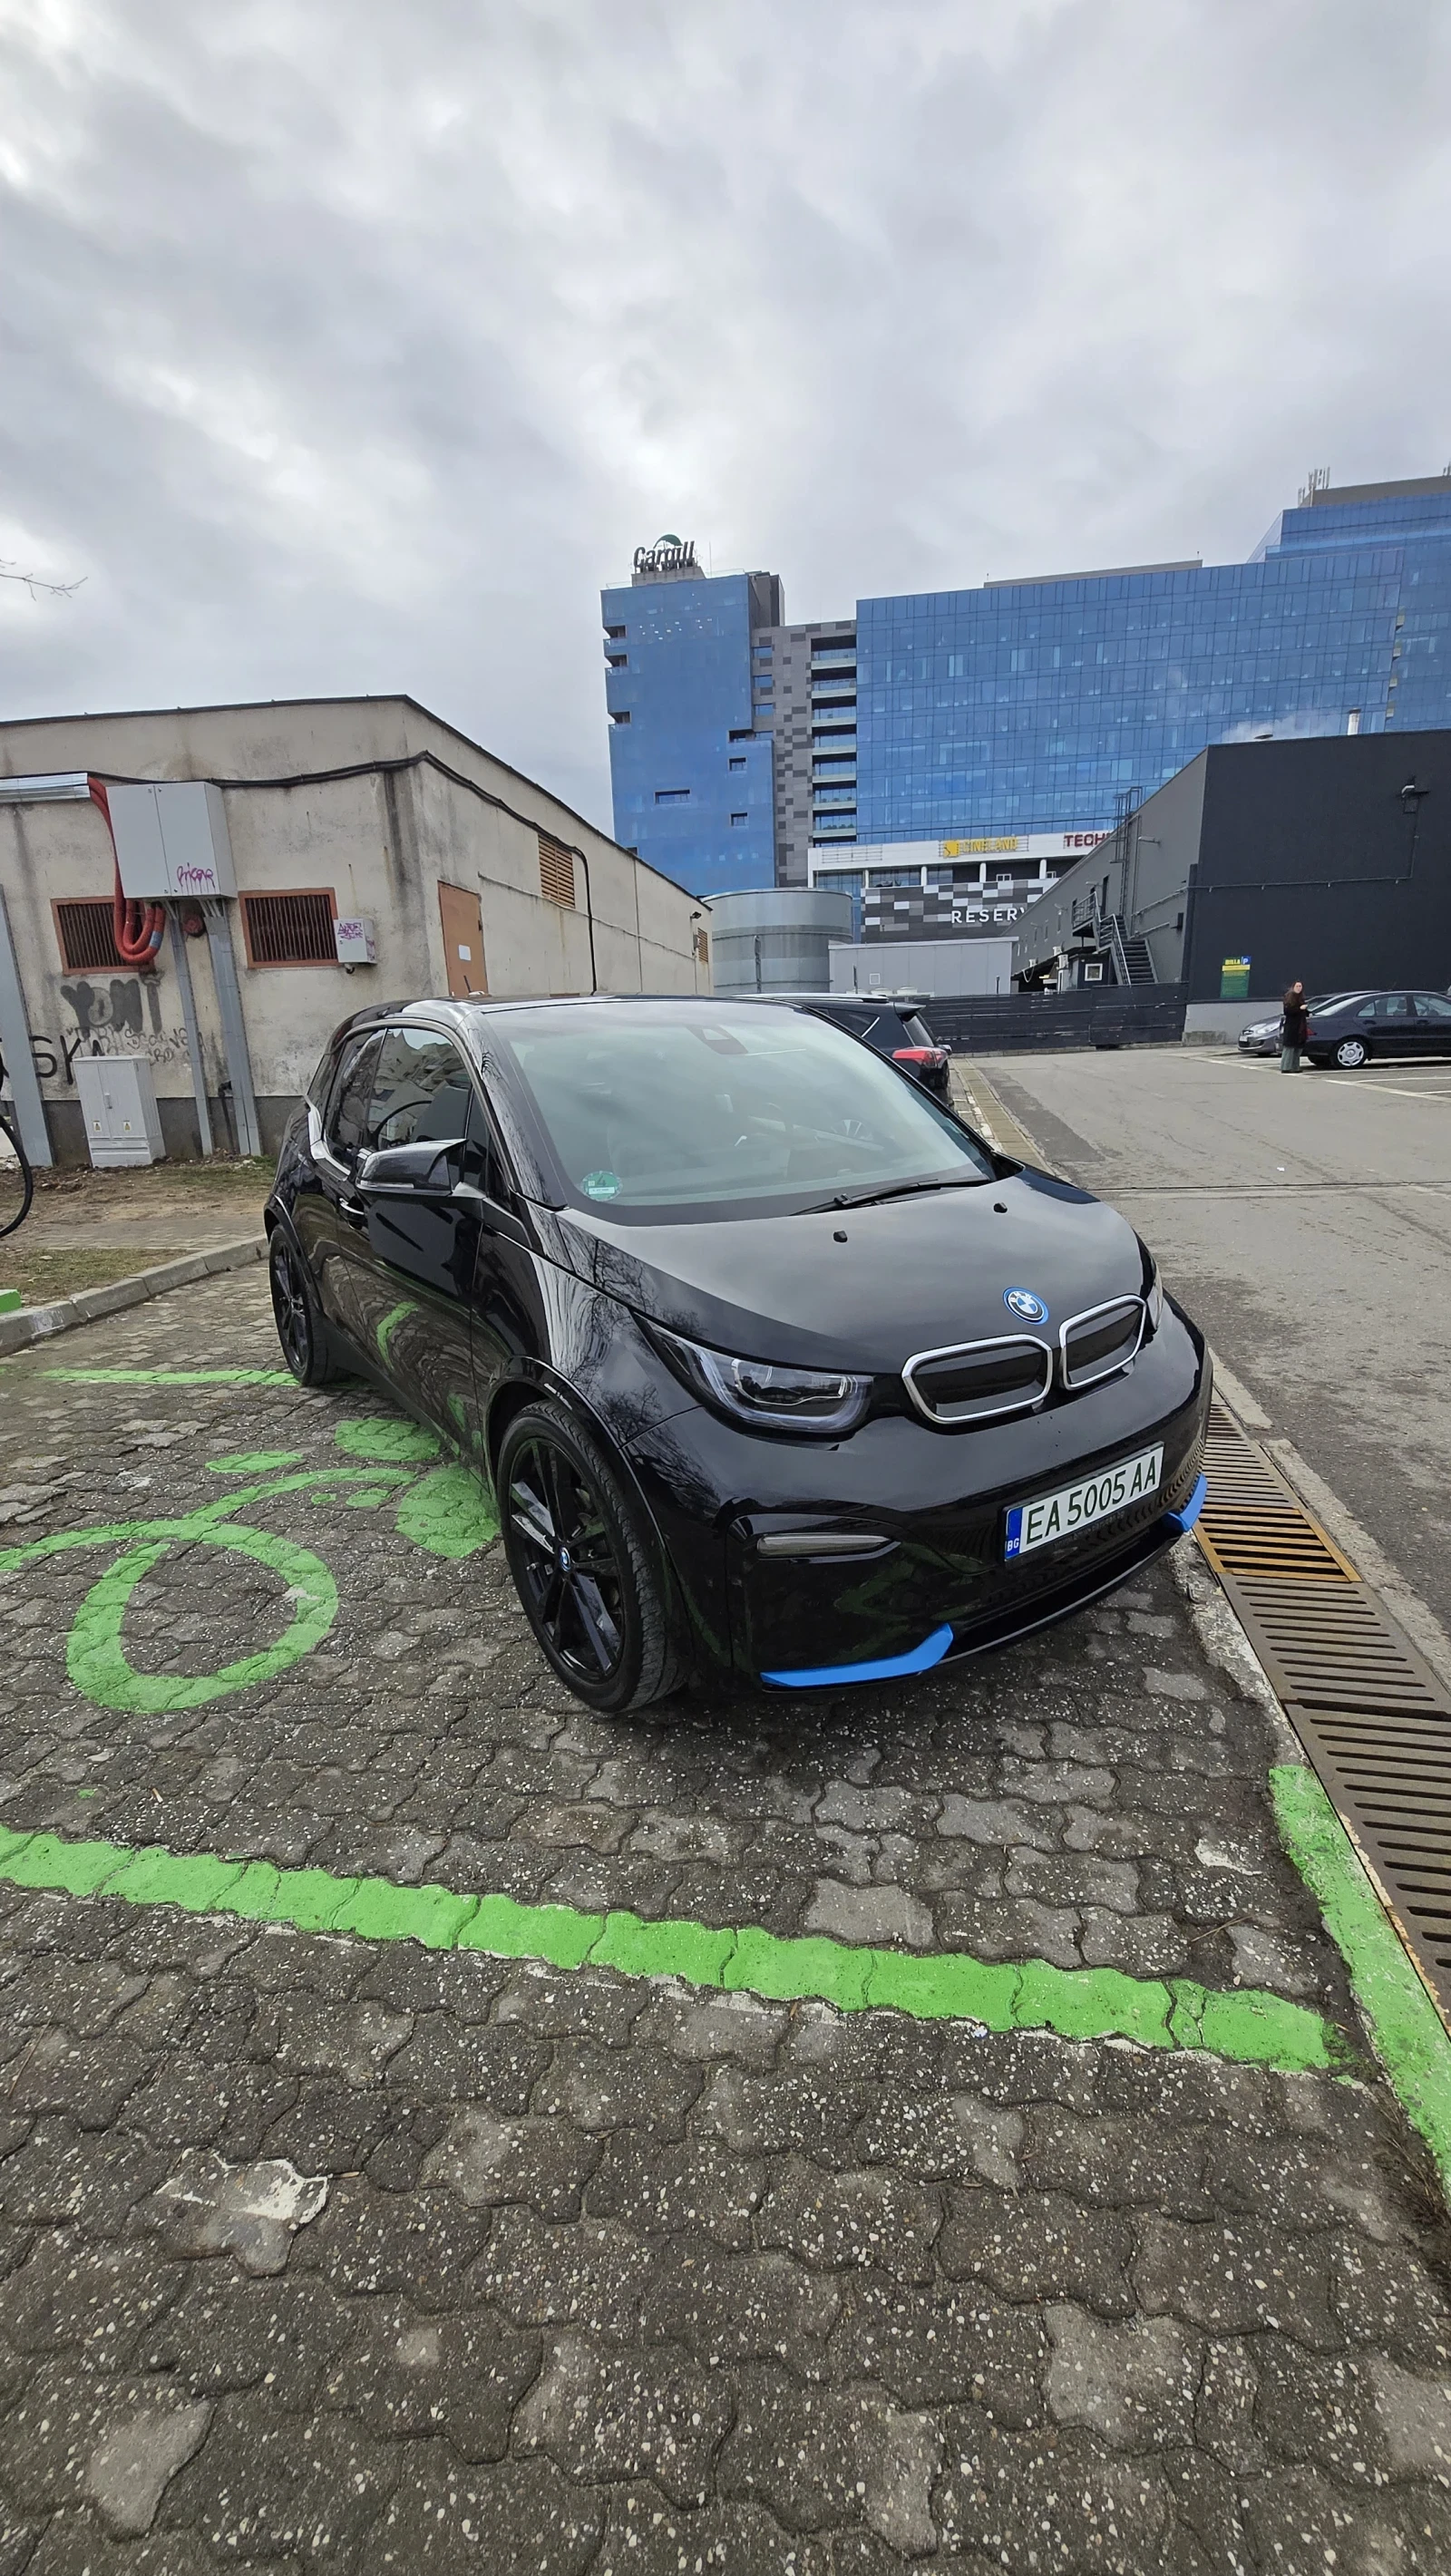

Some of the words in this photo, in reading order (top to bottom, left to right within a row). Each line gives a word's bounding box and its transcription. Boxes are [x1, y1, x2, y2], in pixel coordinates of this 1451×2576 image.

[634, 540, 695, 569] Cargill
[1026, 1499, 1060, 1545] EA
[1067, 1469, 1126, 1526] 5005
[1130, 1455, 1156, 1498] AA
[1007, 1537, 1020, 1551] BG
